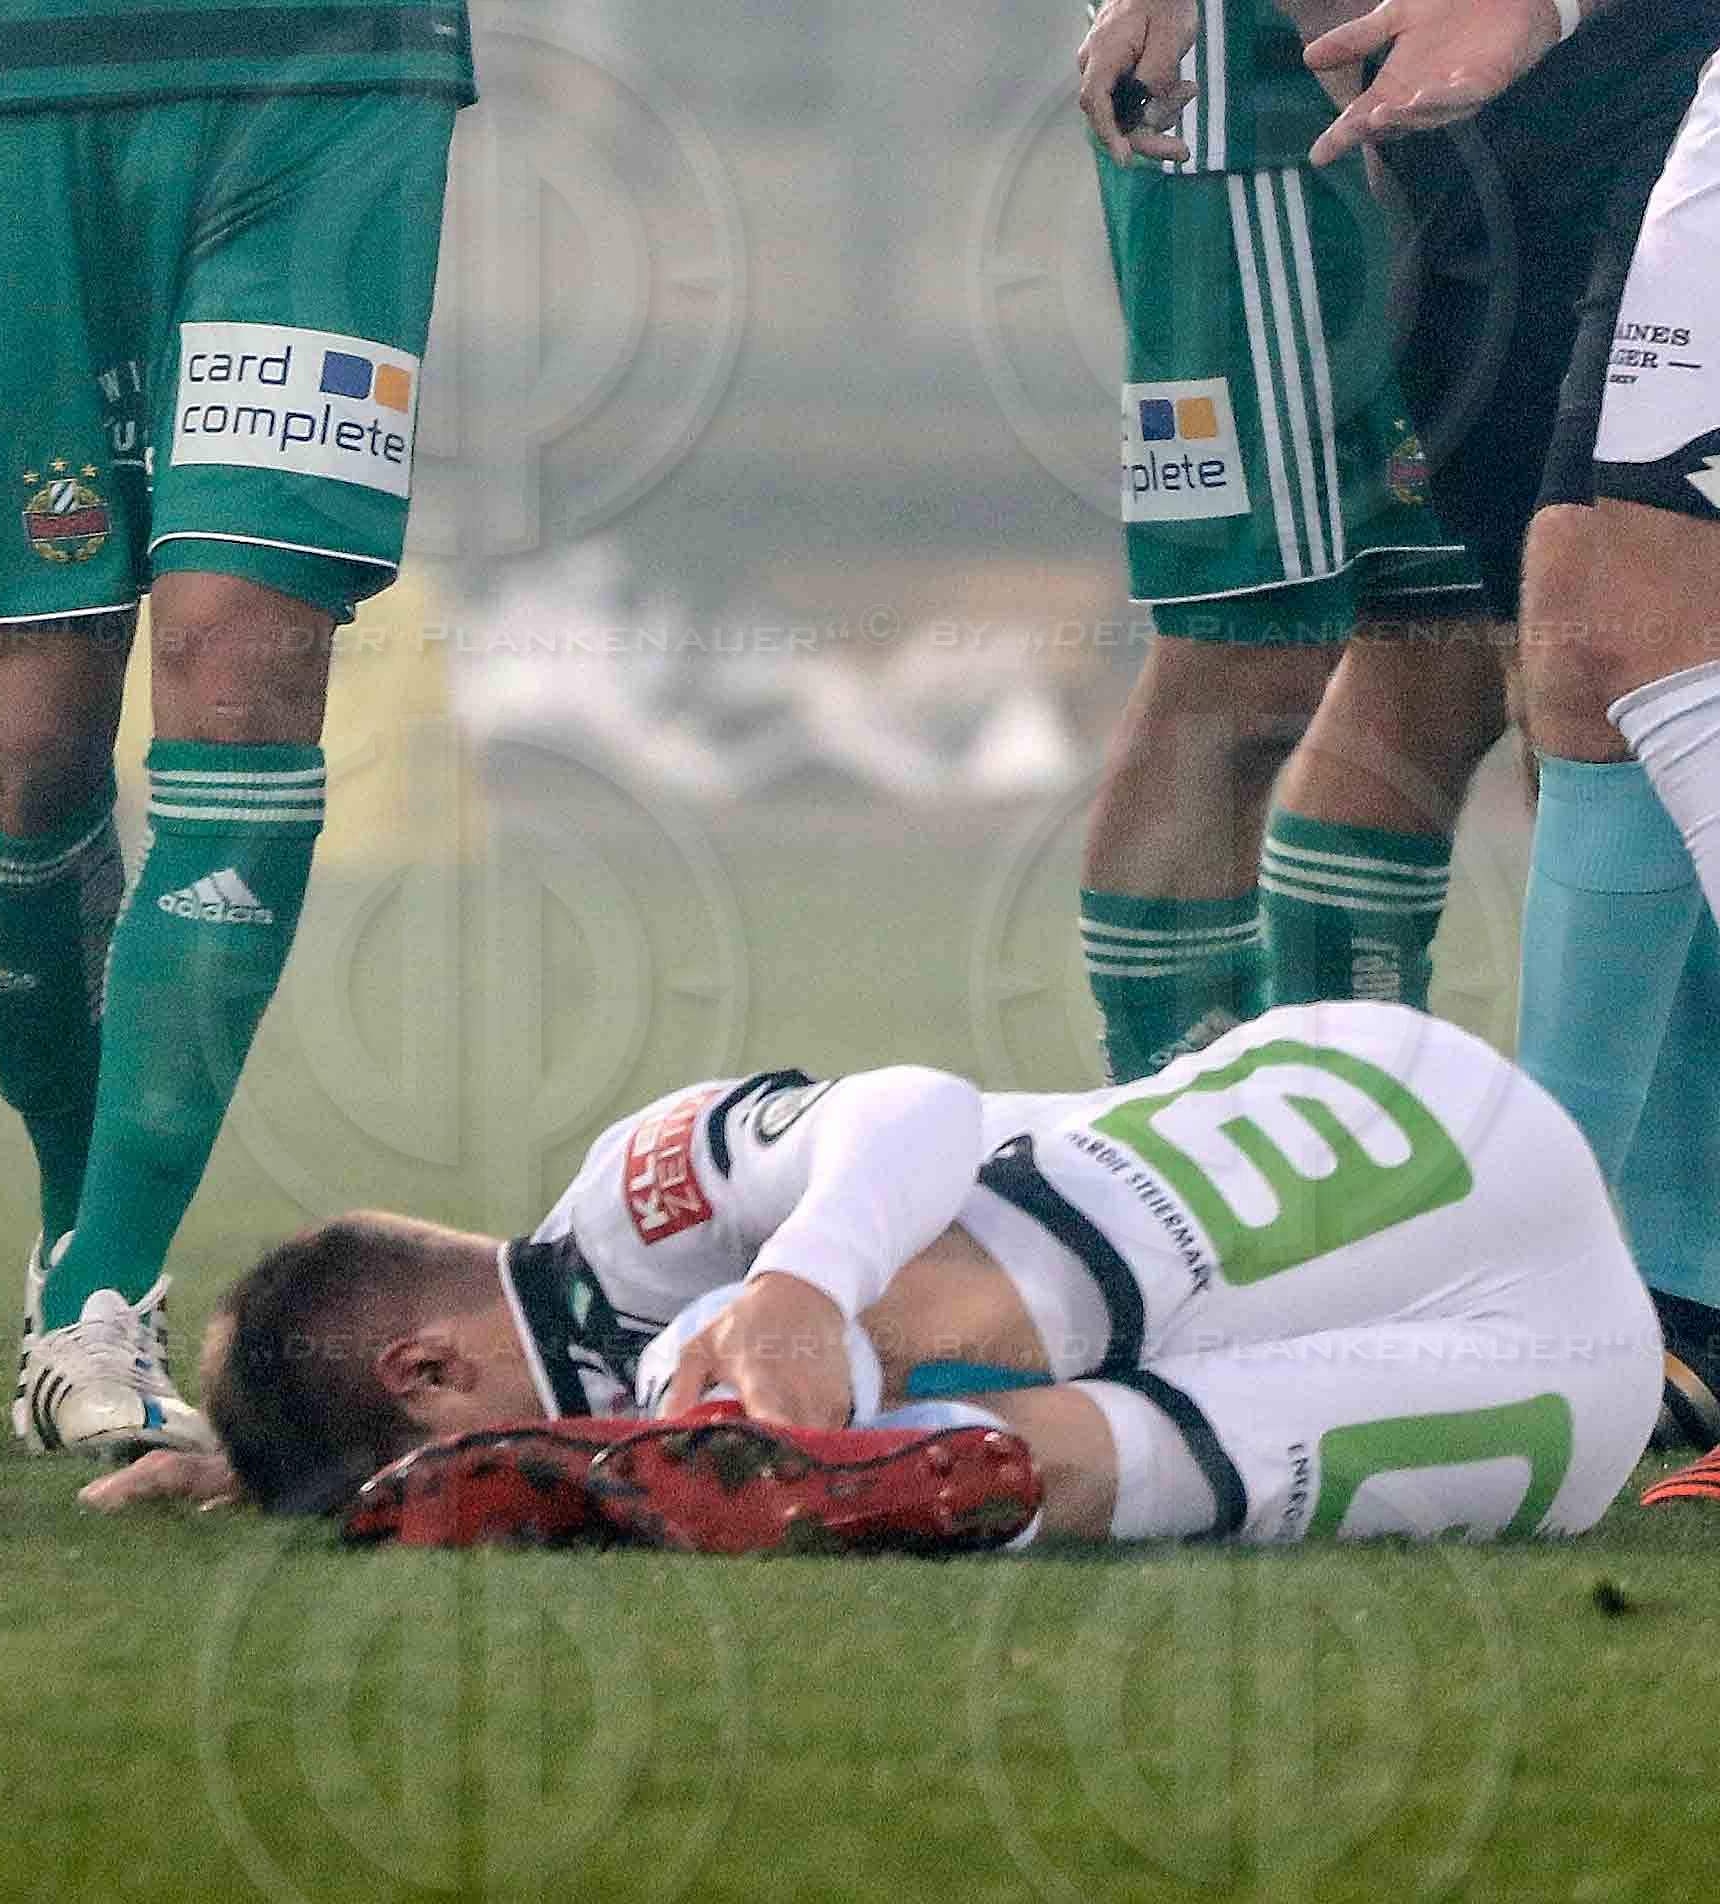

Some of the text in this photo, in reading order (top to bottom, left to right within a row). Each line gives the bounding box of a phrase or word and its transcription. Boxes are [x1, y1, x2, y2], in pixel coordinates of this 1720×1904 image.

[188, 346, 292, 386] card
[182, 404, 405, 464] complete
[1123, 451, 1227, 495] plete
